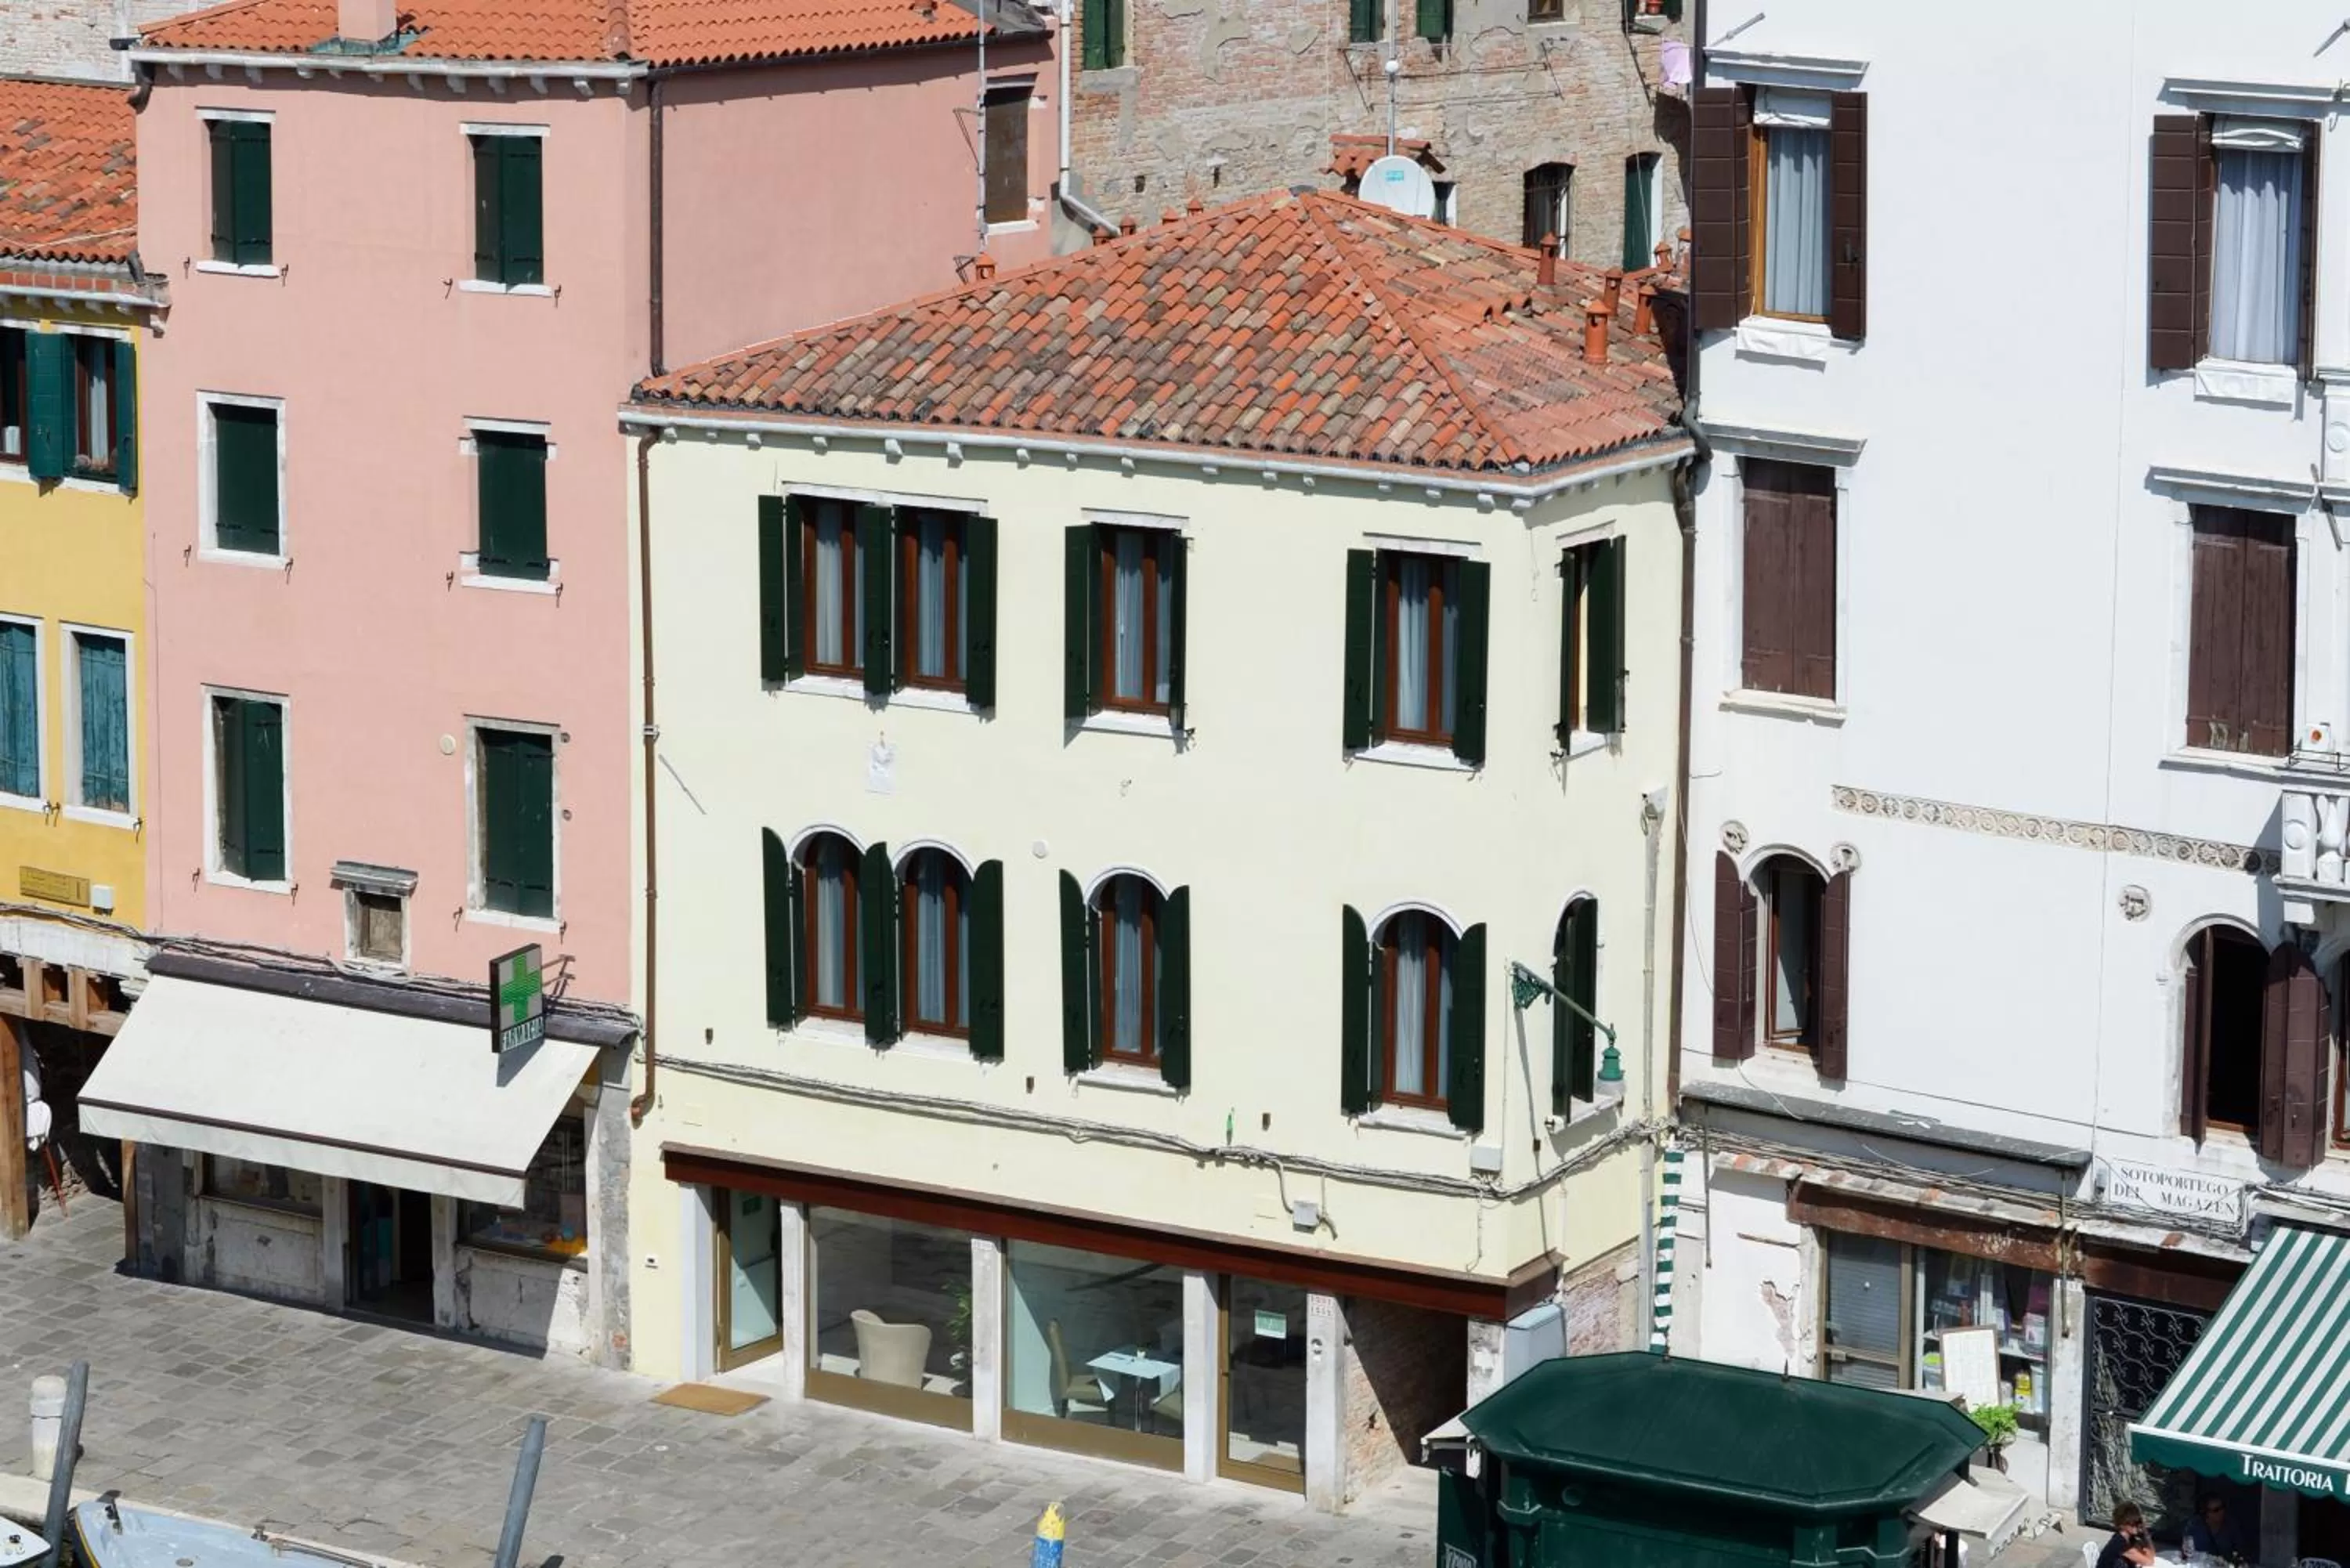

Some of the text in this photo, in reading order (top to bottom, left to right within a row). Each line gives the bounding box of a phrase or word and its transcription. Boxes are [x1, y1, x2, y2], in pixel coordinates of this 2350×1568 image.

[2120, 1167, 2229, 1195] SOTOPORTEGO
[2160, 1191, 2236, 1215] MAGAZEN
[2242, 1454, 2334, 1492] TRATTORIA
